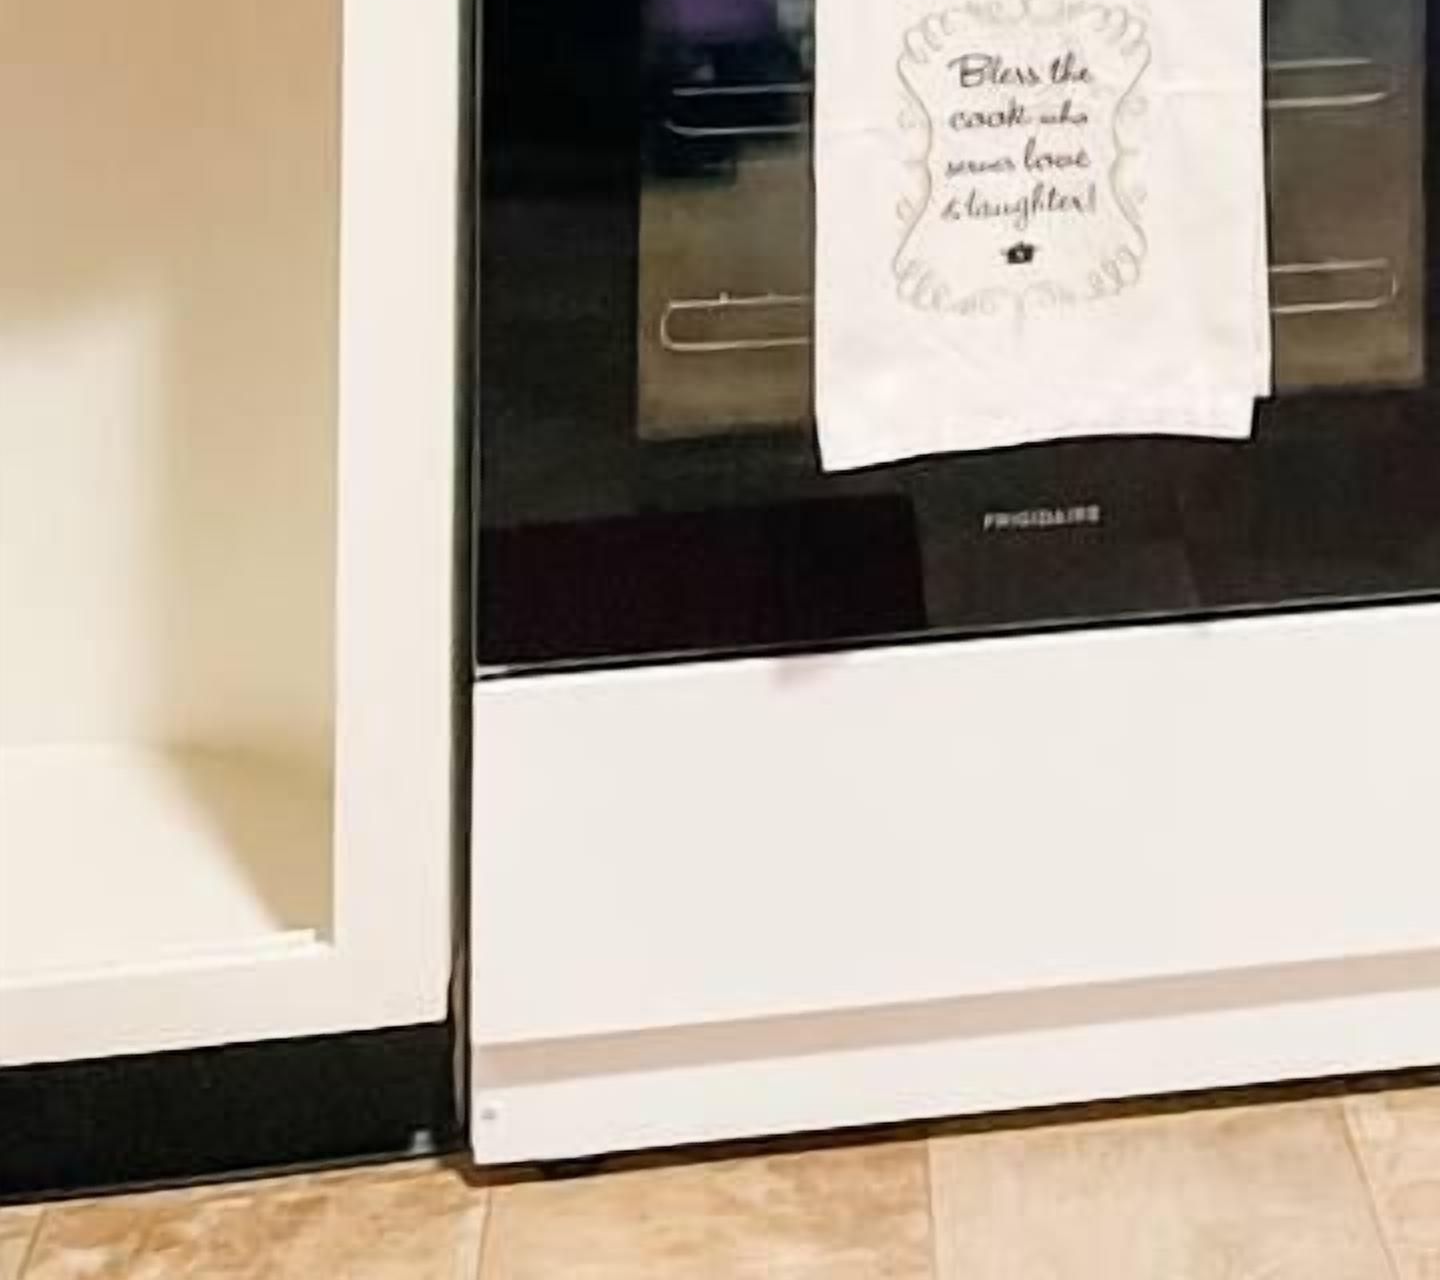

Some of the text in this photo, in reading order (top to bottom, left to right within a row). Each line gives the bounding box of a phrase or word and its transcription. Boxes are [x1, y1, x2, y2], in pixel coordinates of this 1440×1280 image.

[947, 50, 1094, 88] Bless the
[950, 96, 1088, 131] cook who
[1023, 136, 1091, 172] love
